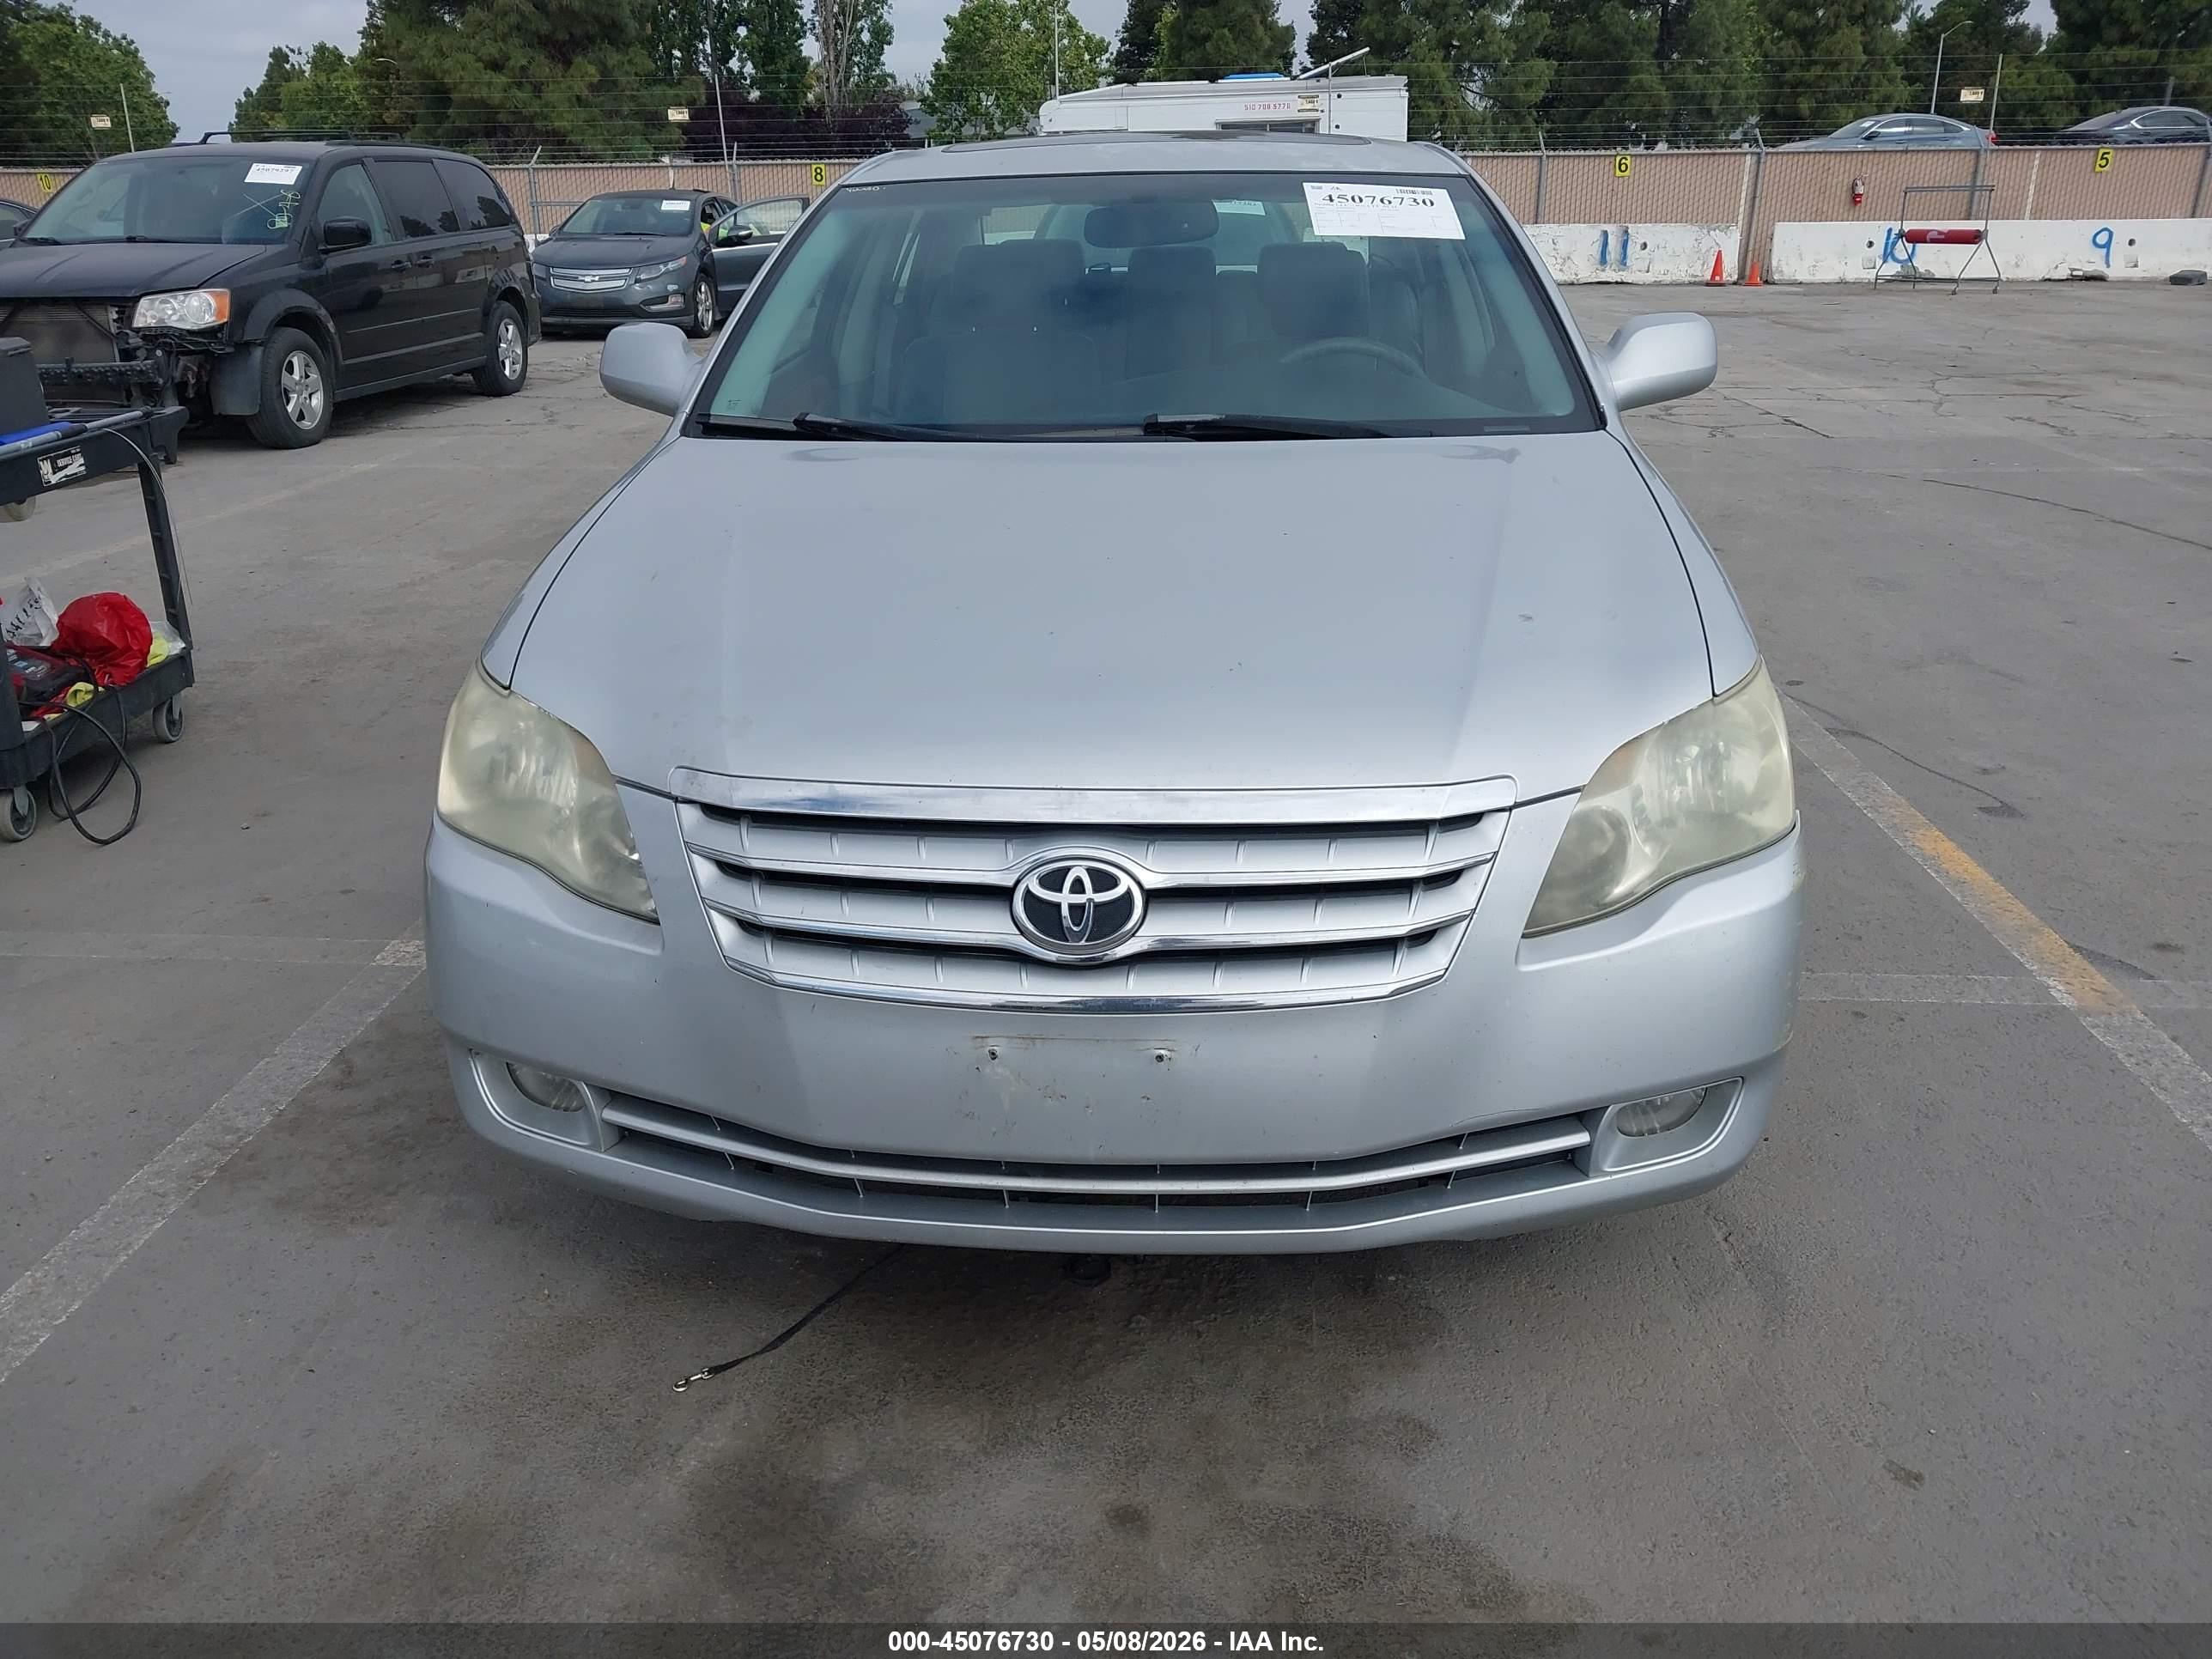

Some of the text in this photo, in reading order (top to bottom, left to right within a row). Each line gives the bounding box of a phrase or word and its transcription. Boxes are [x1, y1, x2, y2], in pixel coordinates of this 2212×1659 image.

[1618, 156, 1629, 173] 6
[2098, 151, 2111, 168] 5
[40, 174, 52, 191] 10
[814, 166, 823, 183] 8
[1322, 193, 1435, 208] 45076730
[2092, 227, 2114, 269] 9
